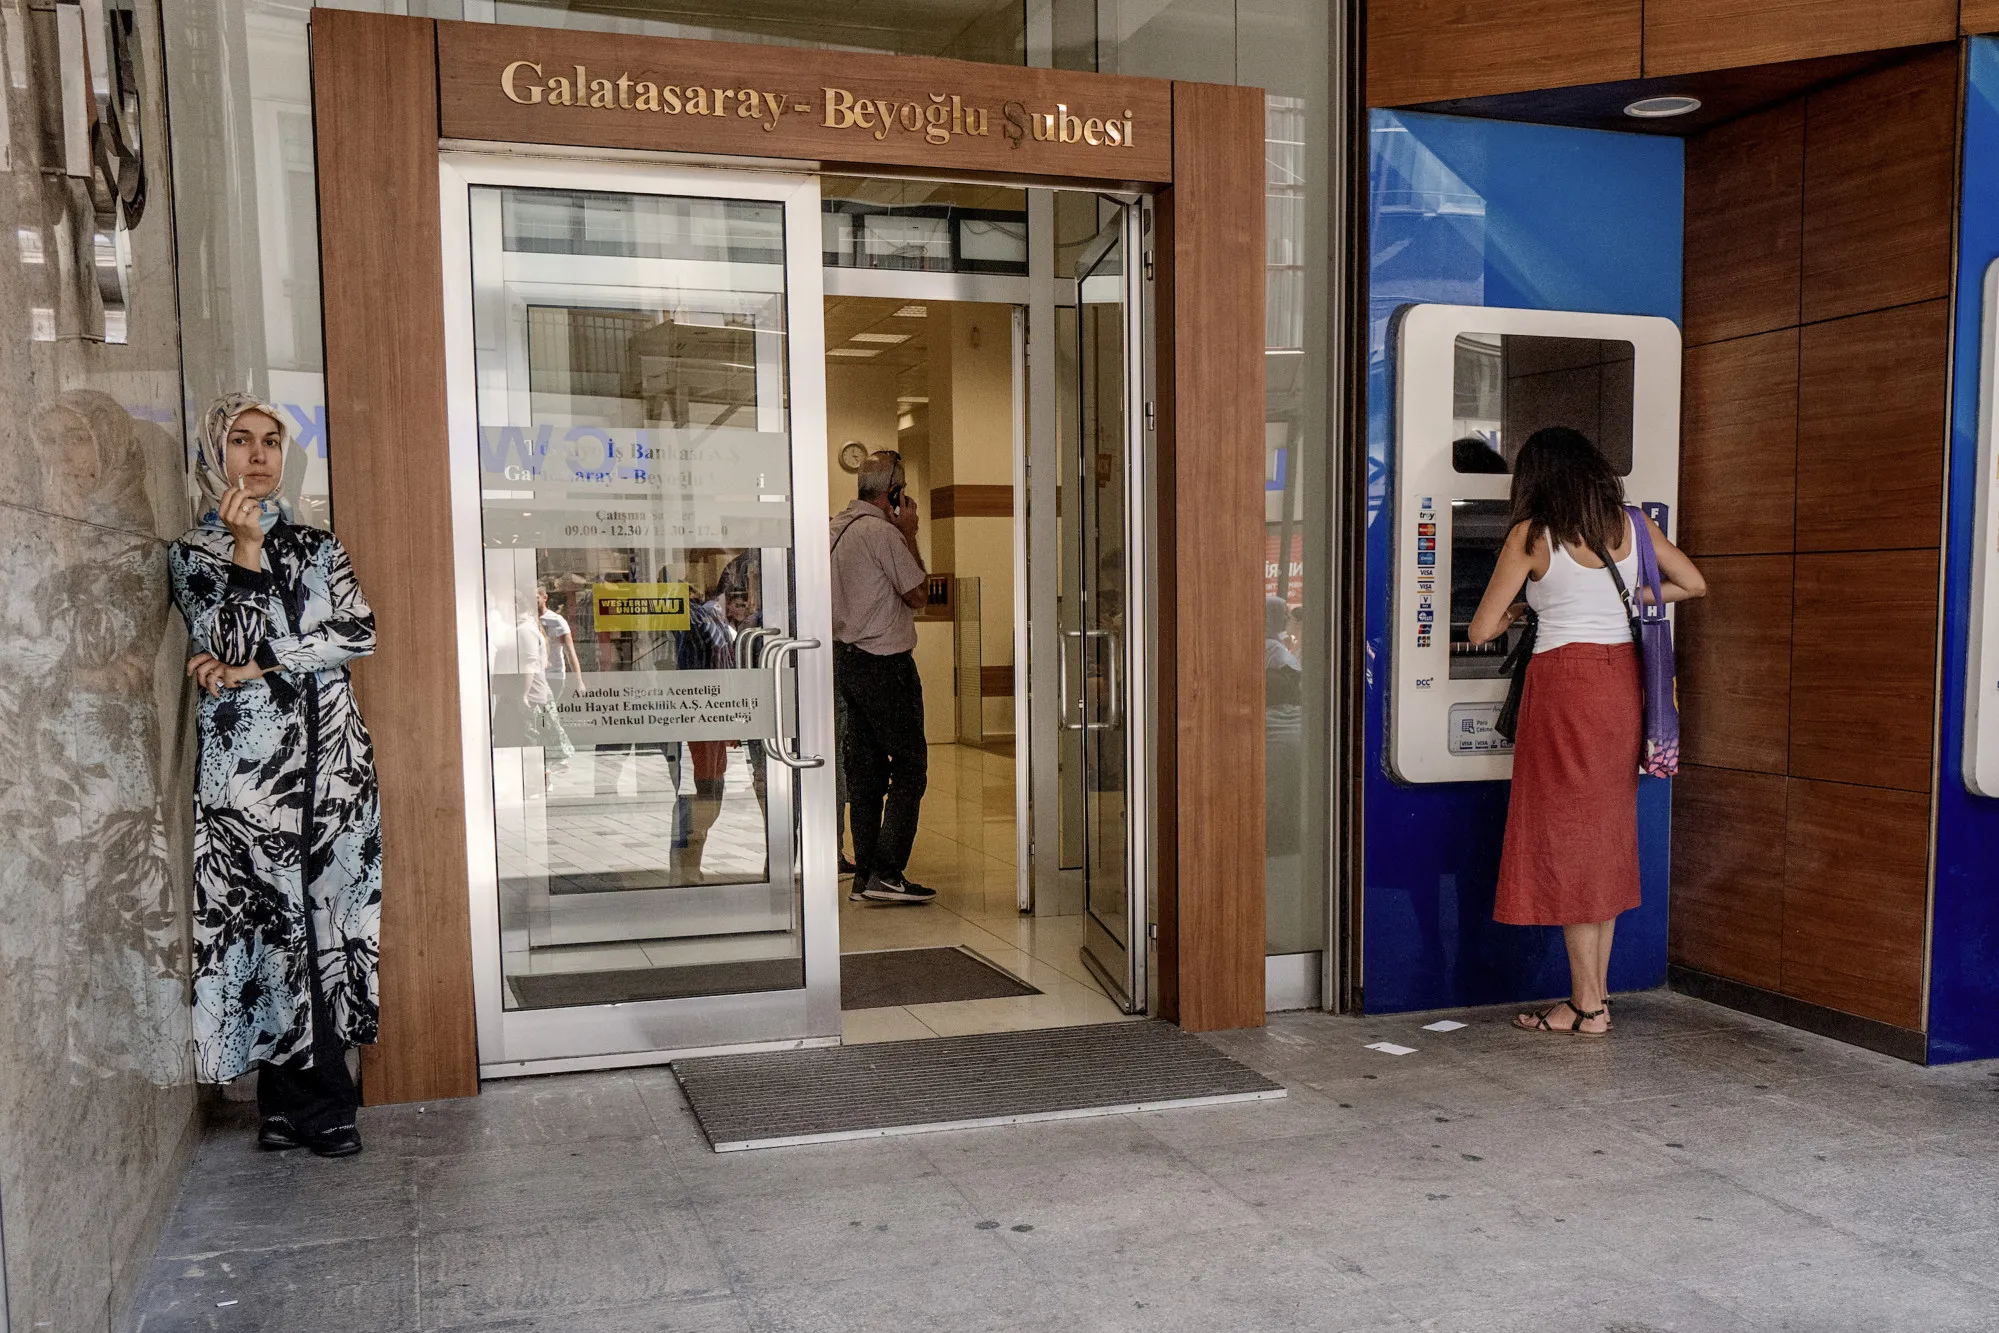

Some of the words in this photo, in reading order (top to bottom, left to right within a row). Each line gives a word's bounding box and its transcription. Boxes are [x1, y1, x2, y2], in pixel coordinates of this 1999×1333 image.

[500, 60, 788, 132] Galatasaray
[821, 87, 989, 145] Beyoğlu
[1003, 100, 1136, 150] Şubesi
[564, 525, 598, 537] 09.00
[610, 525, 642, 537] 12.30
[616, 606, 648, 614] UNION
[623, 687, 664, 699] Sigorta
[666, 685, 721, 697] Acenteliği
[585, 701, 620, 714] Hayat
[623, 699, 677, 712] Emeklilik
[679, 699, 702, 711] A.Ş.
[601, 715, 645, 726] Menkul
